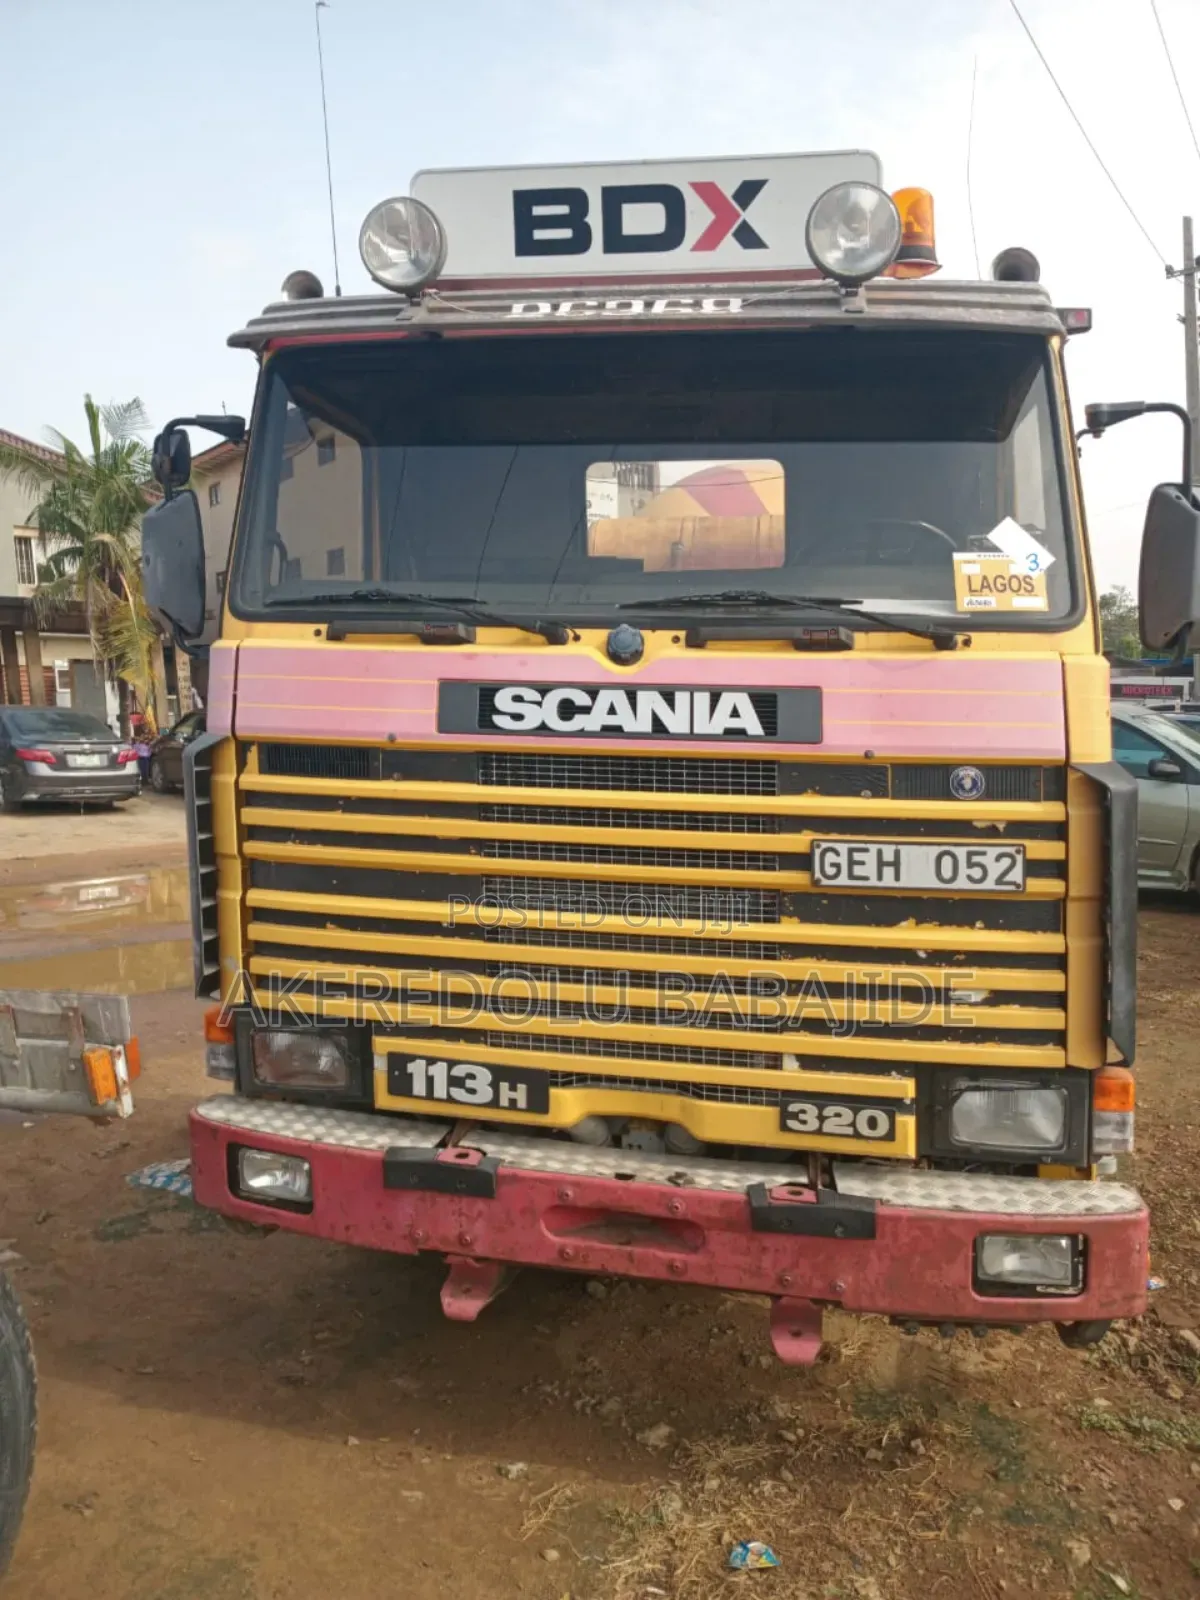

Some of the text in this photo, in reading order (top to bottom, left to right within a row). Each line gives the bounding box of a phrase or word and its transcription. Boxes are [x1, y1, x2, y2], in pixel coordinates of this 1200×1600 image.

[512, 179, 770, 257] BDX
[967, 574, 1035, 594] LAGOS
[491, 686, 765, 736] SCANIA
[818, 846, 1019, 887] GEH 052
[785, 1102, 891, 1138] 320
